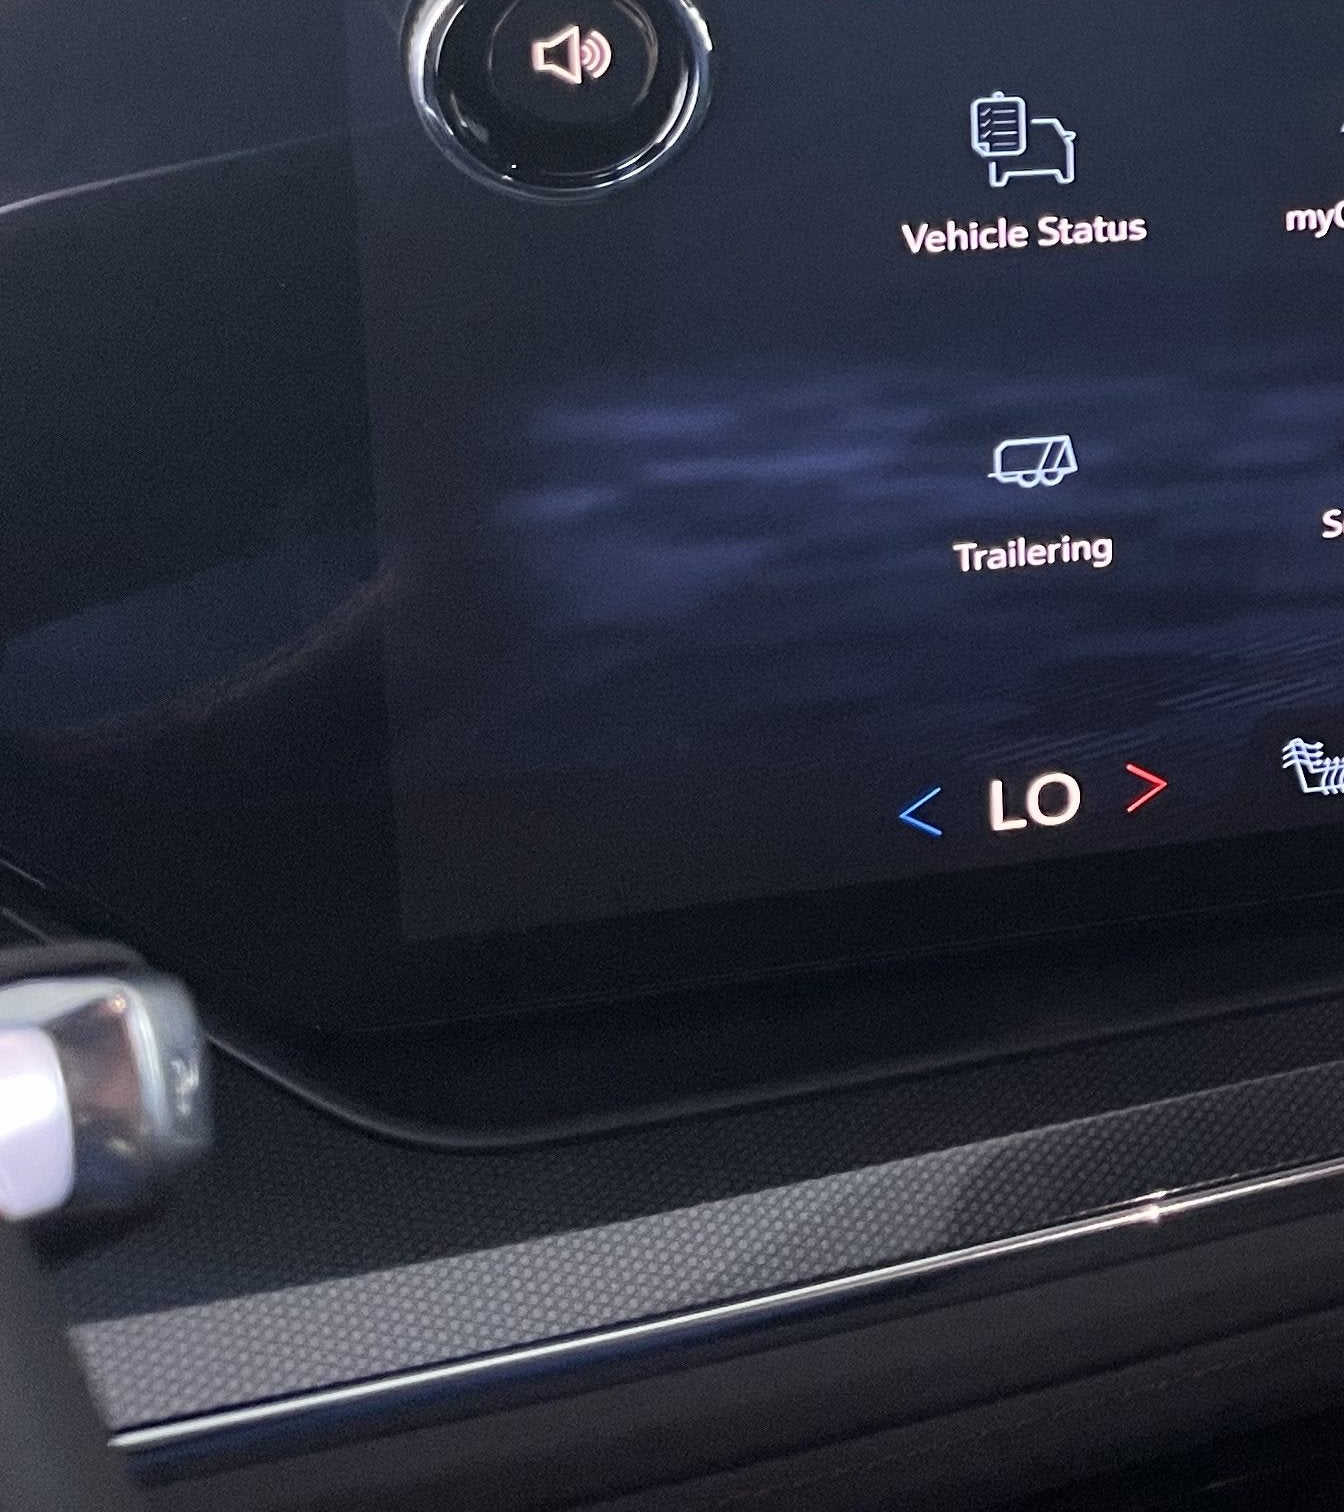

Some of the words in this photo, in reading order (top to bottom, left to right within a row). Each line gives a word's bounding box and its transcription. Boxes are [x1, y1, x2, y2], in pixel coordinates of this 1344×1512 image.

[901, 217, 1029, 254] Vehicle
[1037, 215, 1148, 247] Status
[952, 534, 1113, 572] Trailering
[989, 771, 1081, 831] LO
